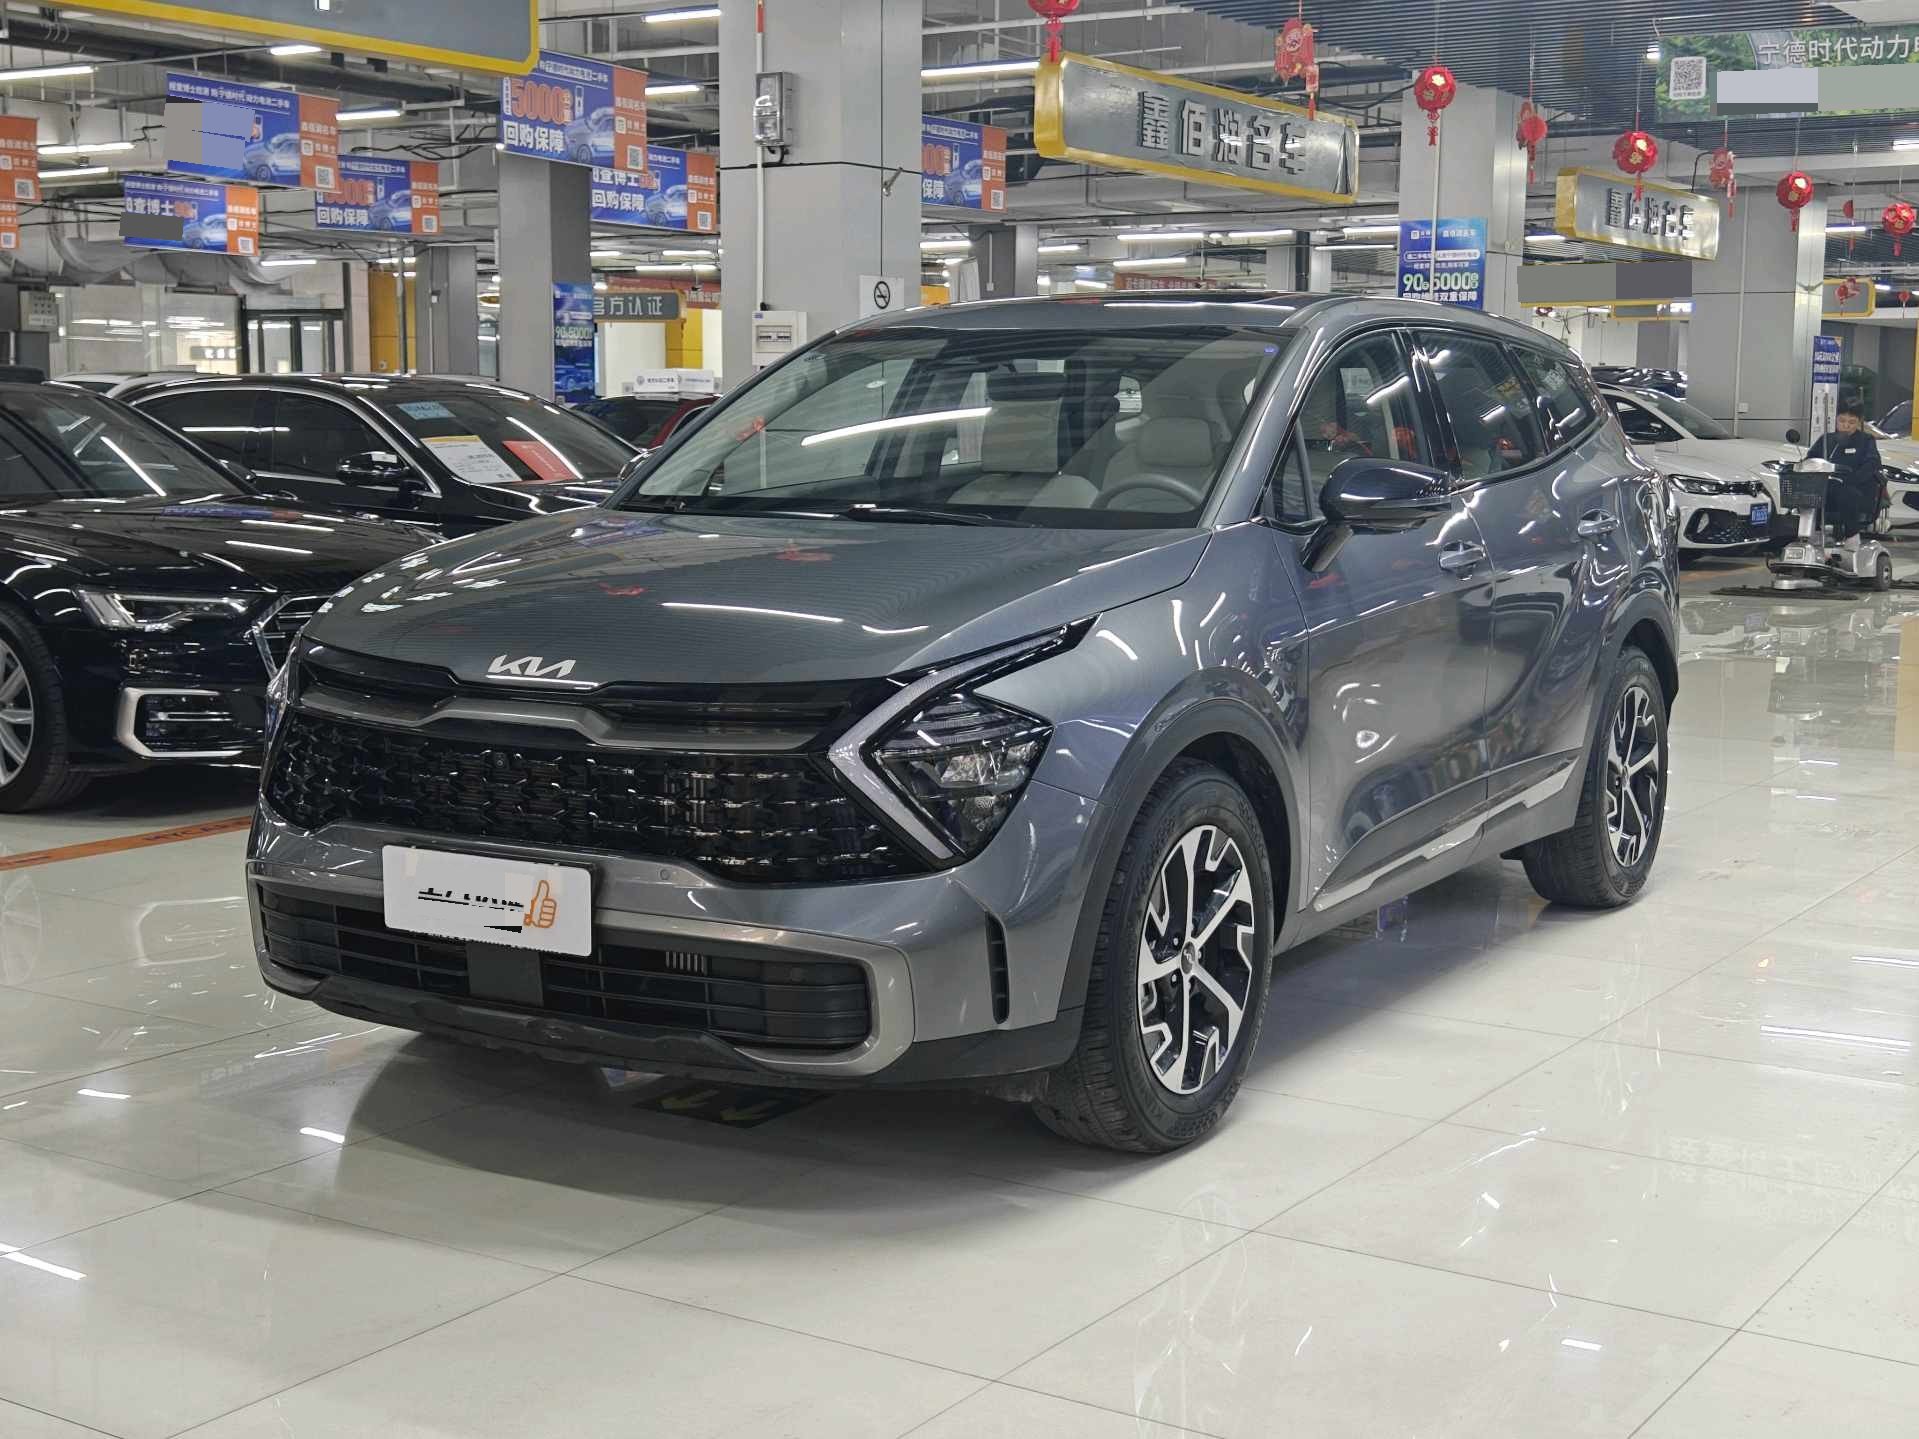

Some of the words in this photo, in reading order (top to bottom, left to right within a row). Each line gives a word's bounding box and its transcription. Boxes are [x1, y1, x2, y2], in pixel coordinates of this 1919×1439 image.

[1757, 34, 1919, 65] 宁德时代动力
[503, 120, 565, 153] 回购保障
[922, 178, 945, 200] 保障
[591, 189, 645, 213] 回购保障
[317, 206, 369, 226] 回购保障
[487, 655, 577, 678] KIA
